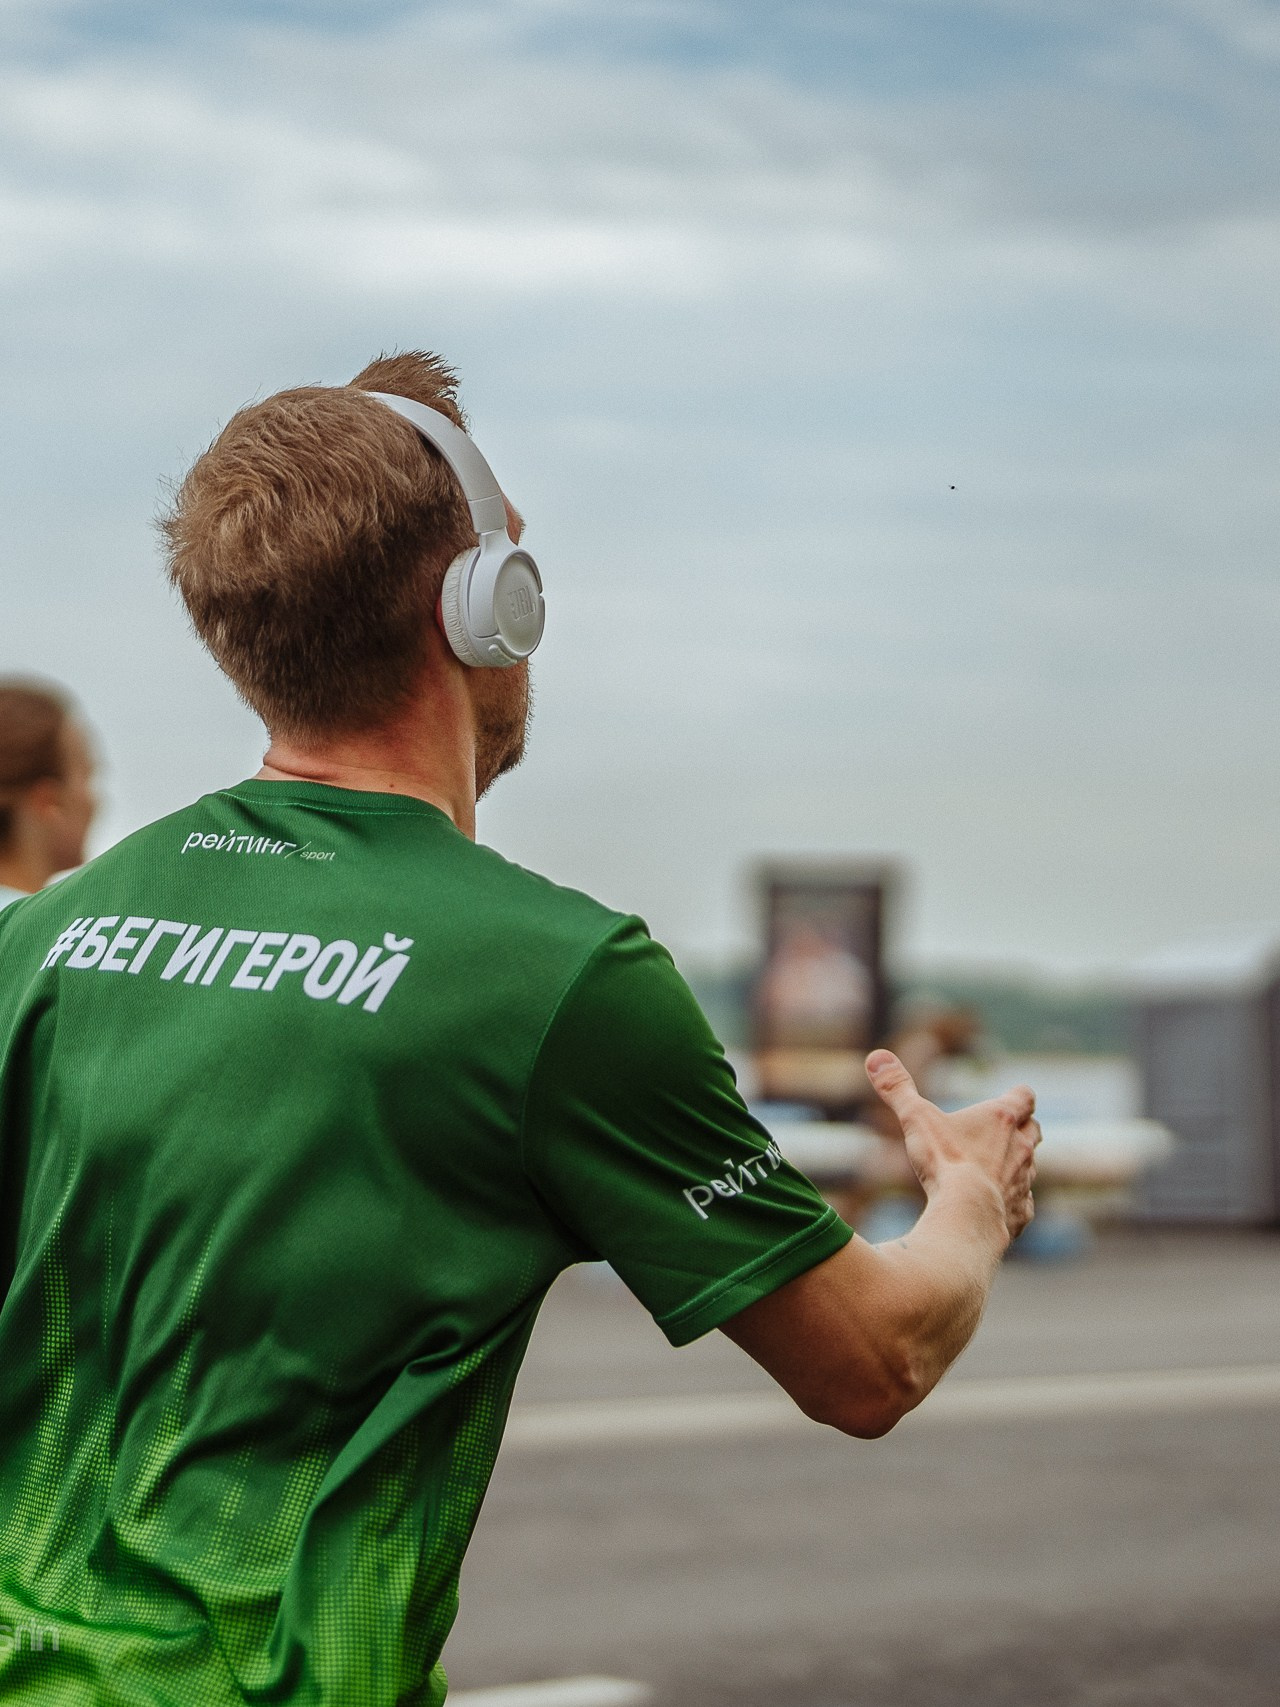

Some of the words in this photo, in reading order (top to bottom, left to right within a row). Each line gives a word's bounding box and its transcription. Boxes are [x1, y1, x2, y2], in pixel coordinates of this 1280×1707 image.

[181, 829, 297, 854] рейтинг
[39, 915, 415, 1014] #БЕГИГЕРОЙ
[682, 1140, 783, 1220] рейти
